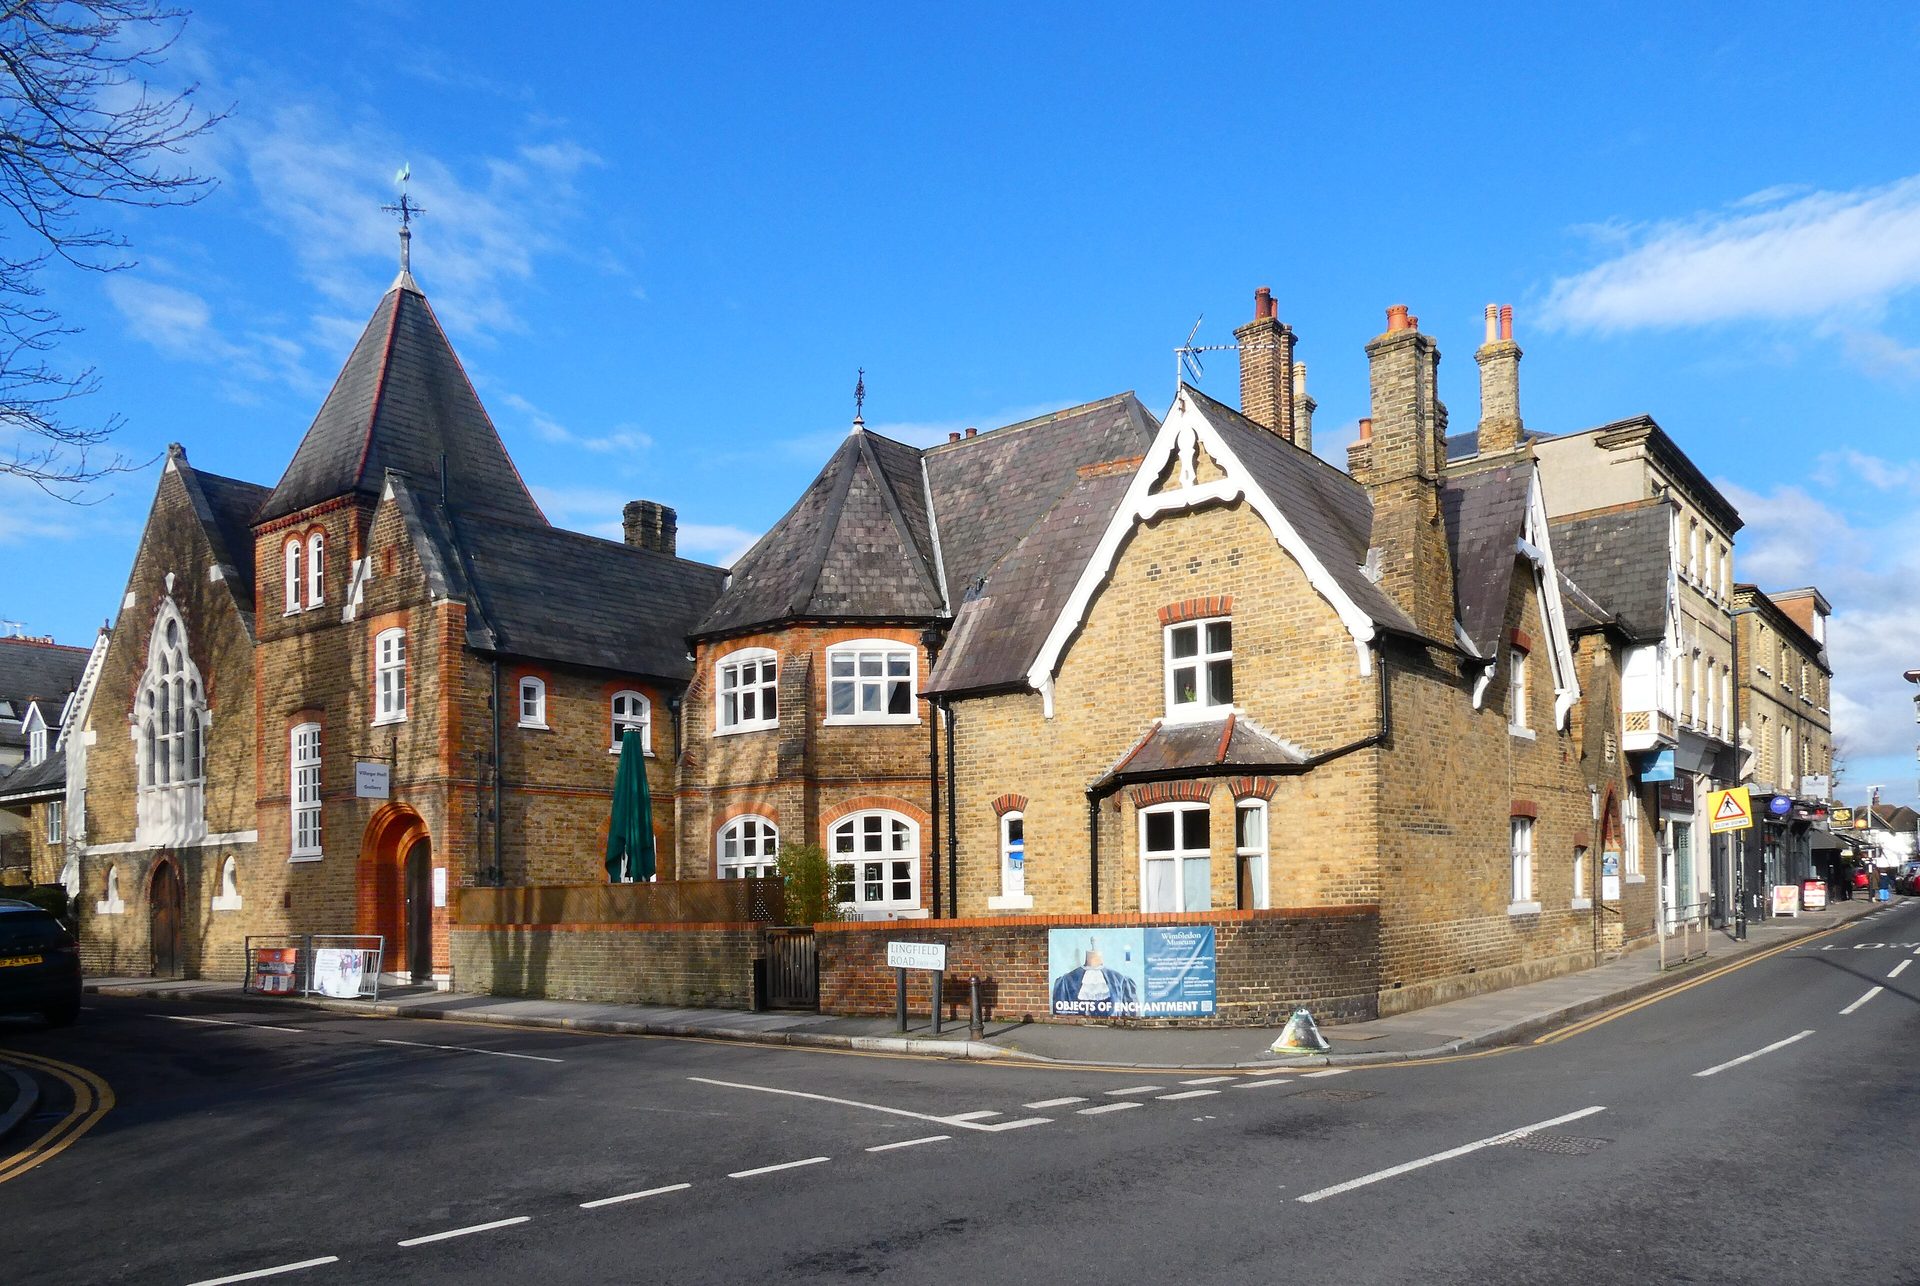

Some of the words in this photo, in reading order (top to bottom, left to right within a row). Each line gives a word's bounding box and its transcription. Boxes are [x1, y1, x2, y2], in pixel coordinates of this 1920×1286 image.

[1161, 931, 1202, 940] Wimbledon
[891, 944, 939, 955] LINGFIELD
[891, 956, 916, 966] ROAD
[1055, 1000, 1096, 1012] OBJECTS
[1098, 1001, 1113, 1012] OF
[1115, 1001, 1199, 1012] ENCHANTMENT
